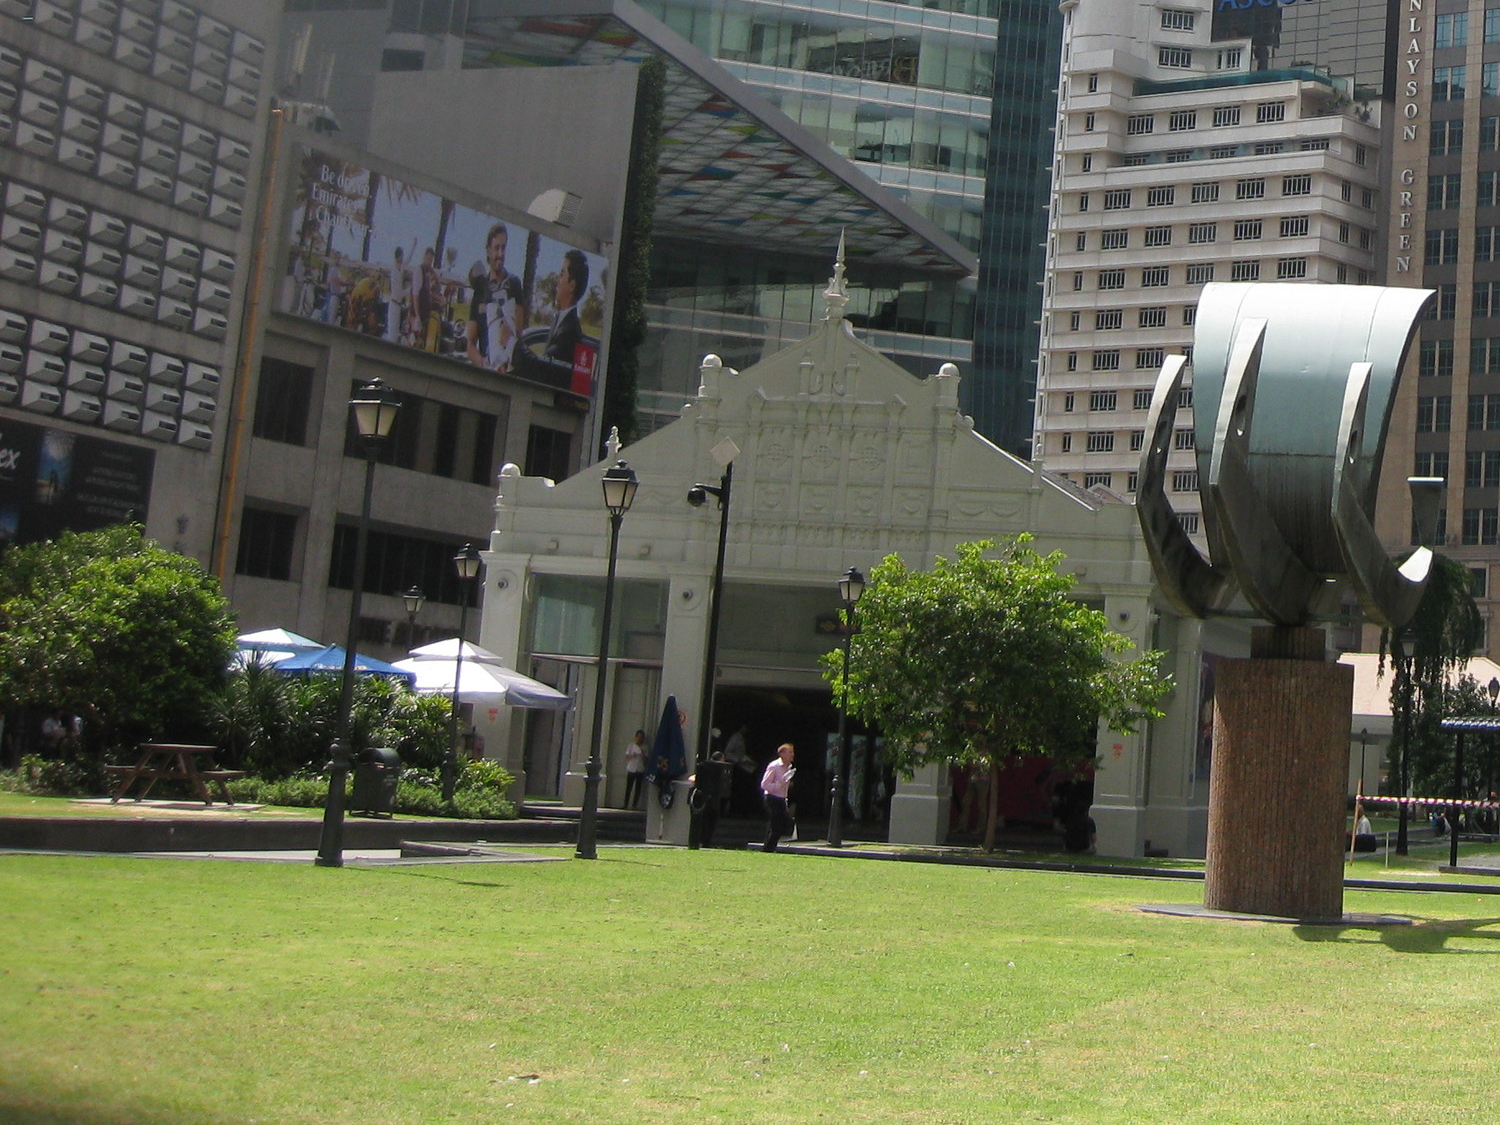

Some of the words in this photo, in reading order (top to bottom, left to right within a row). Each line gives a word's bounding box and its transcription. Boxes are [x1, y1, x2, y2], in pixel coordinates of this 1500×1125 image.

[321, 164, 335, 185] Be
[313, 182, 357, 213] Emirates
[1396, 169, 1414, 272] GREEN
